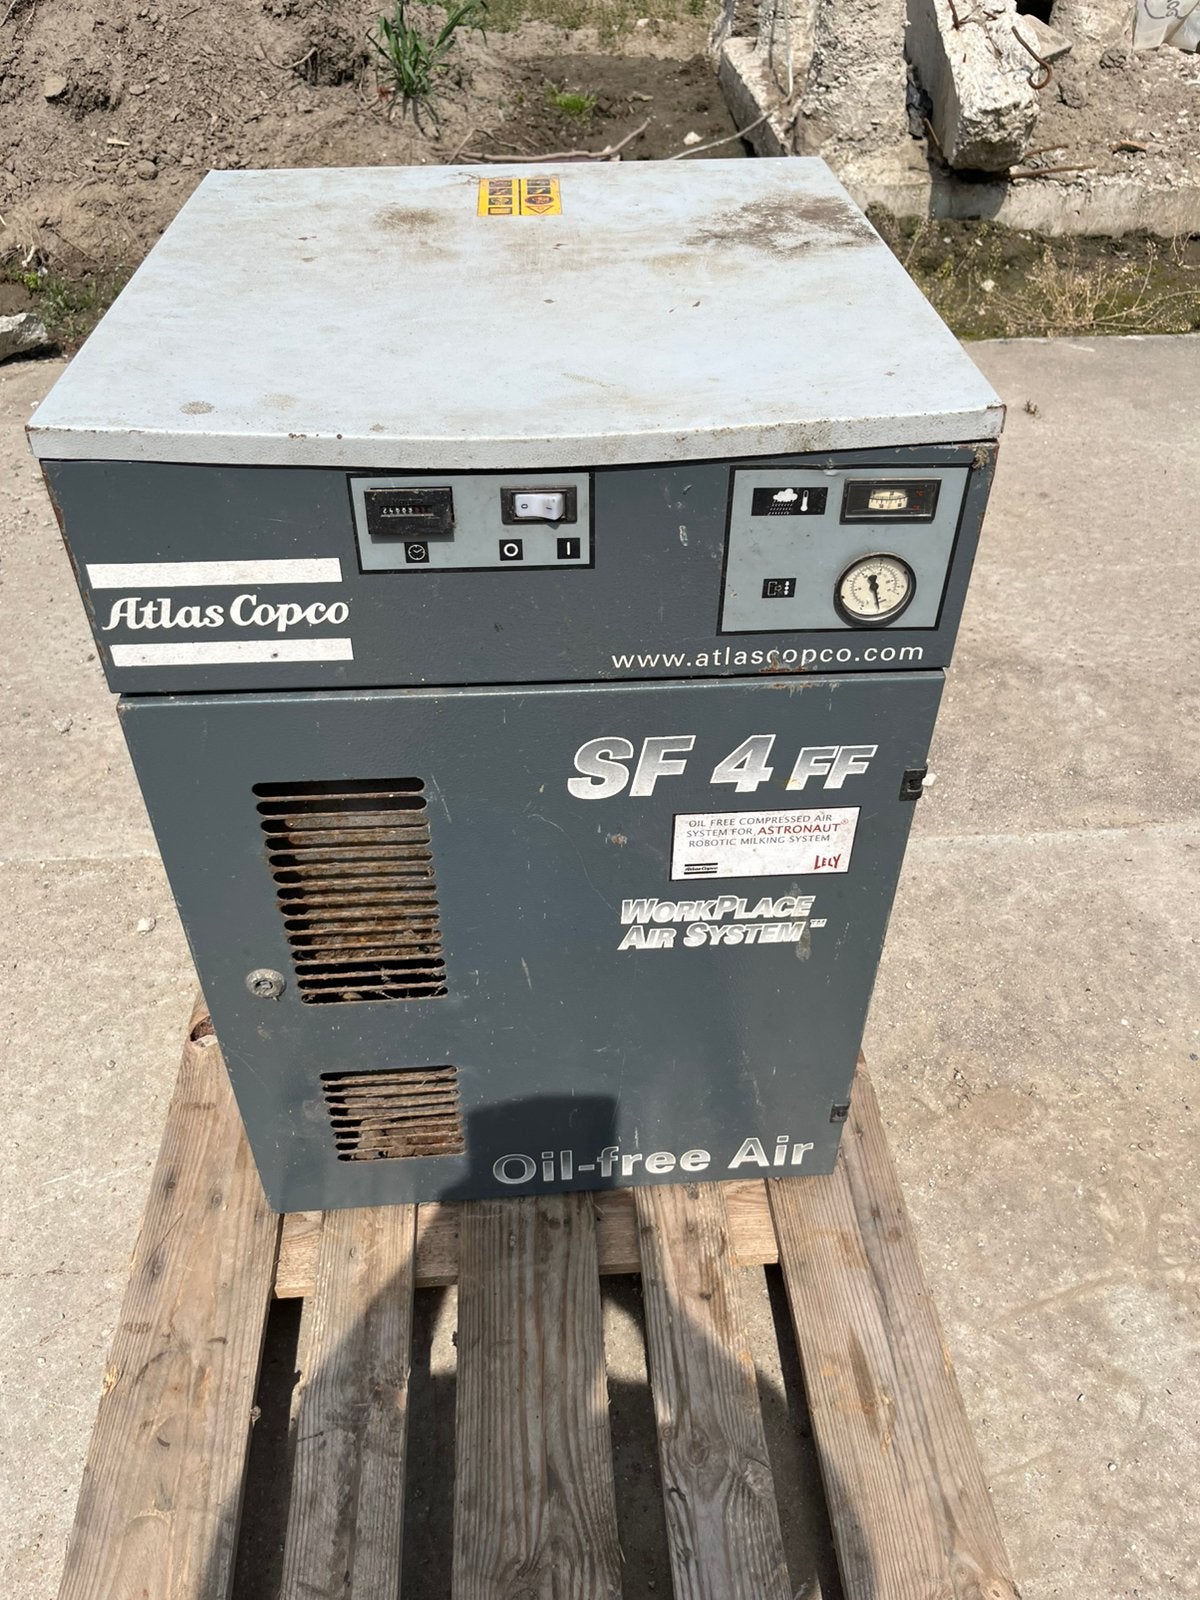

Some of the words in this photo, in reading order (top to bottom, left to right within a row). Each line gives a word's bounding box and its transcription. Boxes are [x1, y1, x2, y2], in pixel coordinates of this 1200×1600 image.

[101, 596, 225, 631] Atlas
[229, 594, 350, 633] Copco
[611, 646, 924, 669] www.atlascopco.com
[567, 734, 696, 800] SF
[709, 733, 777, 793] 4
[785, 744, 879, 791] FF
[686, 828, 728, 838] SYSTEM
[731, 828, 753, 836] FOR
[757, 823, 841, 836] ASTRONAUT
[688, 819, 706, 828] OIL
[710, 818, 735, 827] FREE
[739, 815, 811, 826] COMPRESSED
[814, 814, 833, 822] AIR
[688, 838, 737, 848] ROBOTIC
[740, 836, 785, 845] MILKING
[789, 834, 830, 843] SYSTEM
[814, 853, 842, 870] LELY
[492, 1146, 711, 1184] Oil-free
[727, 1135, 814, 1169] Air
